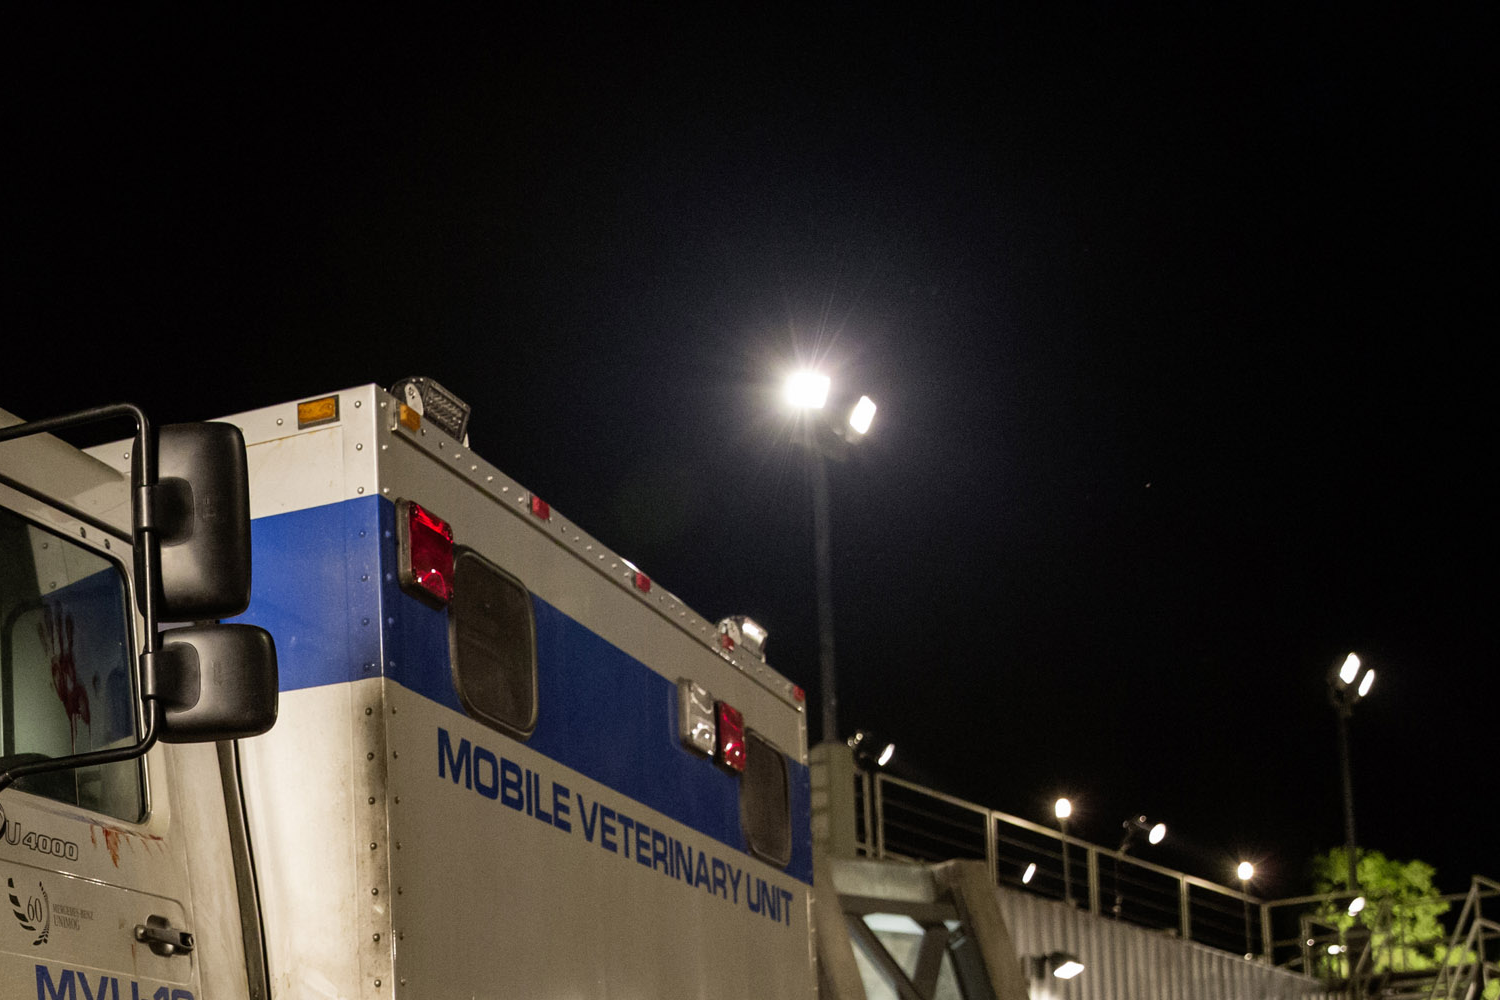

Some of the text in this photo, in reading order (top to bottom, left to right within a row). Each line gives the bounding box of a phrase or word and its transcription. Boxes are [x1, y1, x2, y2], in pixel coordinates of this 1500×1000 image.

[438, 727, 793, 926] MOBILE VETERINARY UNIT
[27, 895, 42, 922] 60
